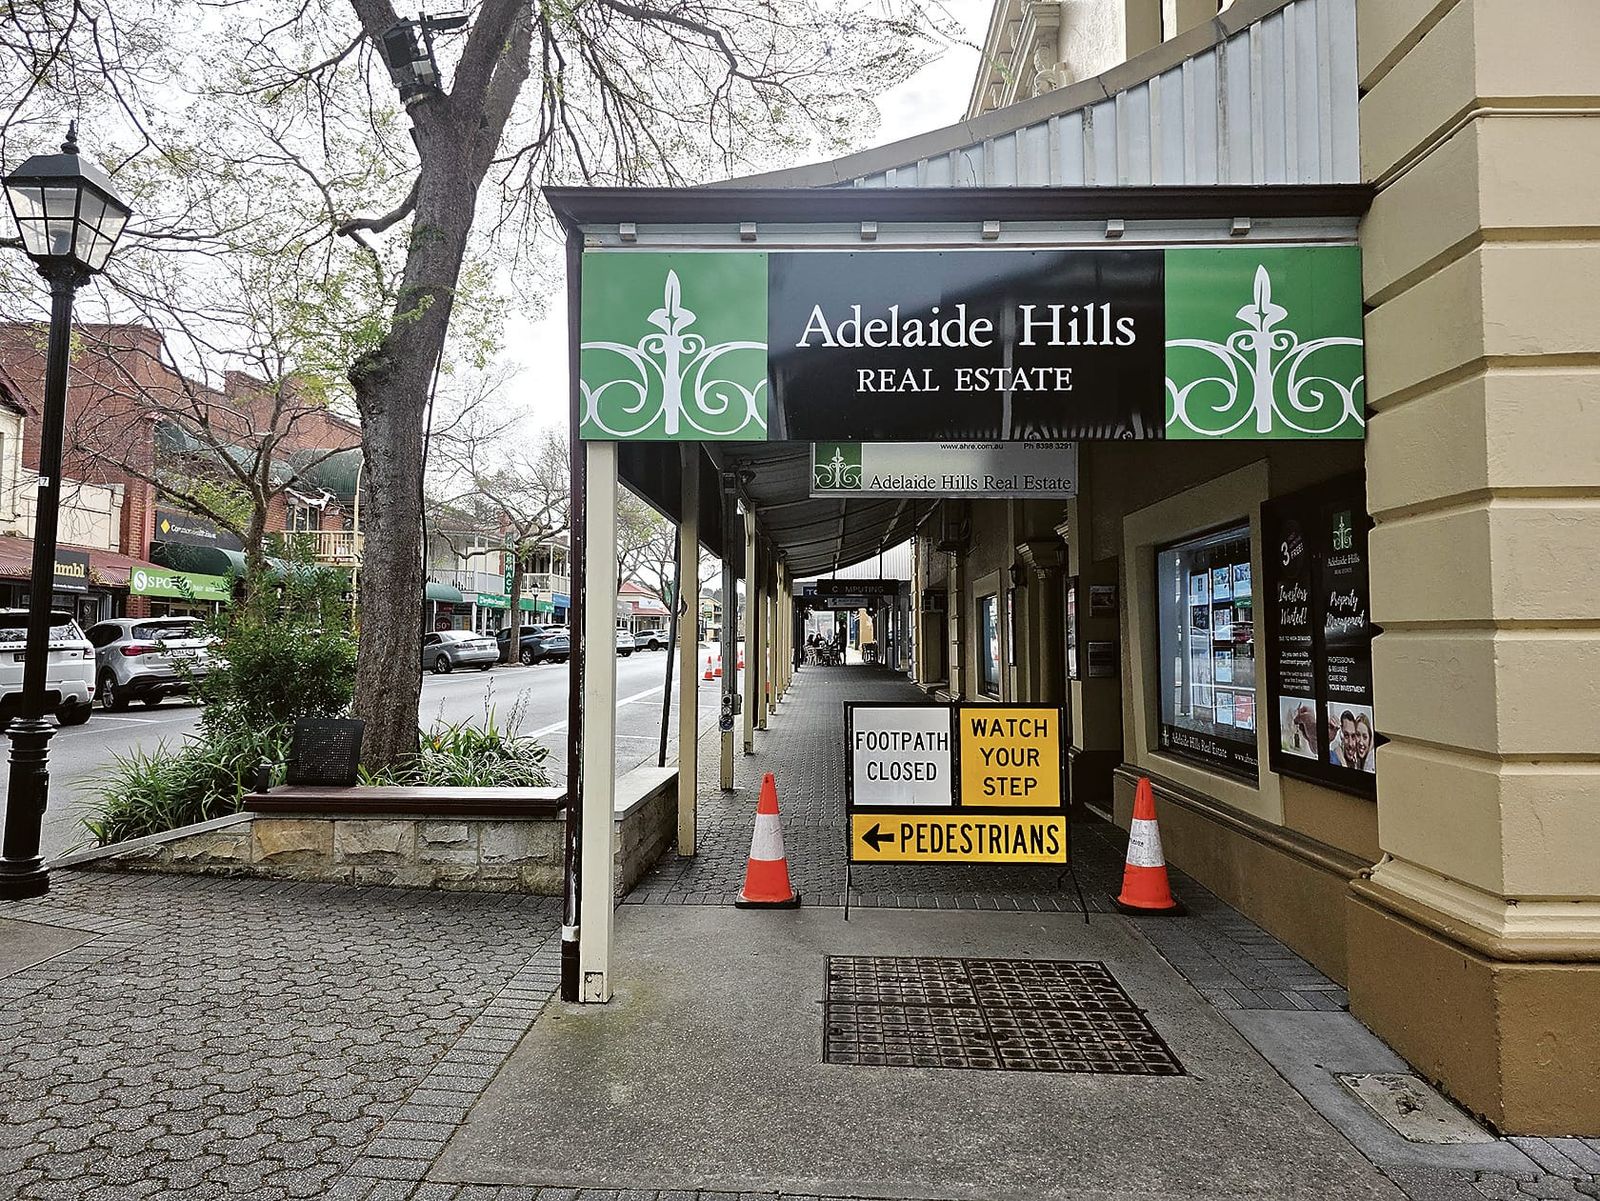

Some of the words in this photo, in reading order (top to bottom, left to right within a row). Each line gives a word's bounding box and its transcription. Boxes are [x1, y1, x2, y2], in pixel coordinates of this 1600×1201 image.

[796, 303, 993, 347] Adelaide
[1018, 302, 1136, 346] Hills
[857, 368, 940, 392] REAL
[954, 367, 1073, 392] ESTATE
[1023, 442, 1034, 450] Ph
[870, 475, 936, 491] Adelaide
[942, 475, 978, 490] Hills
[983, 475, 1018, 490] Real
[1023, 475, 1072, 490] Estate
[1281, 541, 1290, 566] 3
[1329, 588, 1359, 612] Property
[1326, 610, 1364, 632] Management
[971, 718, 1048, 738] WATCH
[855, 731, 948, 751] FOOTPATH
[979, 747, 1040, 767] YOUR
[867, 761, 937, 781] CLOSED
[983, 776, 1038, 796] STEP
[900, 823, 1060, 855] PEDESTRIANS
